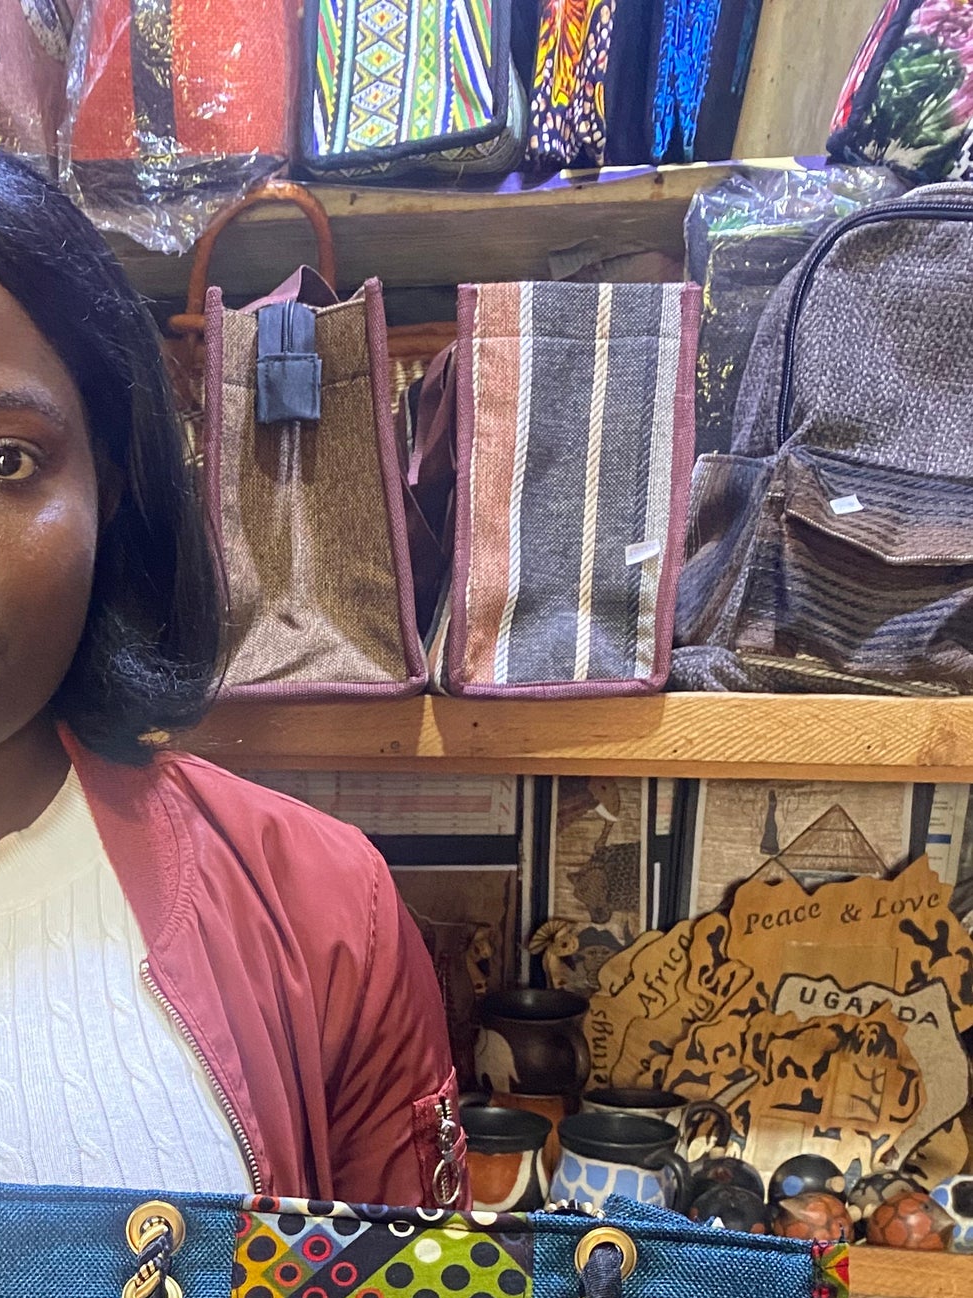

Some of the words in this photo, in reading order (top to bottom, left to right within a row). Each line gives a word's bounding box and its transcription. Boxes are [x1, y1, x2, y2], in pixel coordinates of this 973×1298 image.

[744, 902, 822, 935] Peace
[840, 903, 861, 924] &
[871, 892, 940, 920] Love
[637, 934, 693, 1019] Africa
